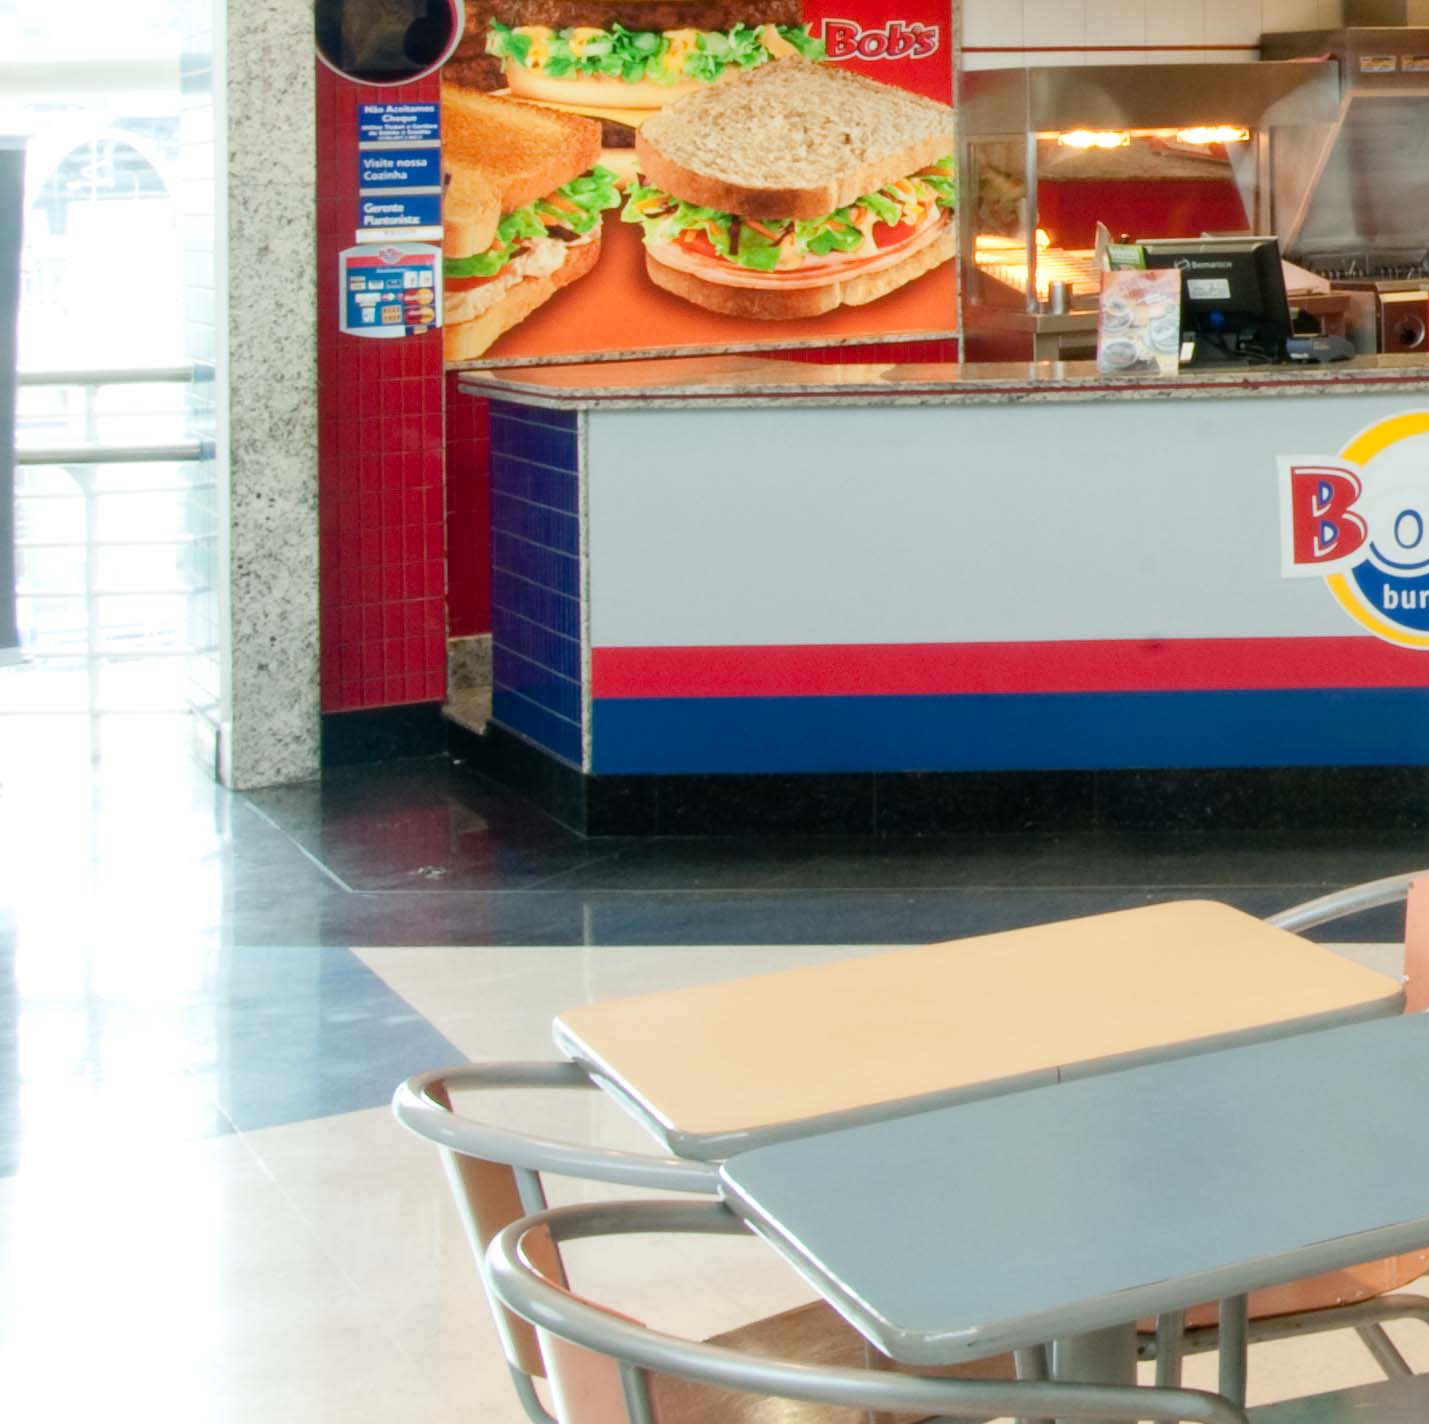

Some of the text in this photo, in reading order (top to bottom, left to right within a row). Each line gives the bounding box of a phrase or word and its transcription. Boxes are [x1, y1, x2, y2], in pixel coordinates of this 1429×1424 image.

[821, 17, 940, 62] Bob's
[363, 159, 394, 168] Visite
[363, 170, 408, 181] Cozinha
